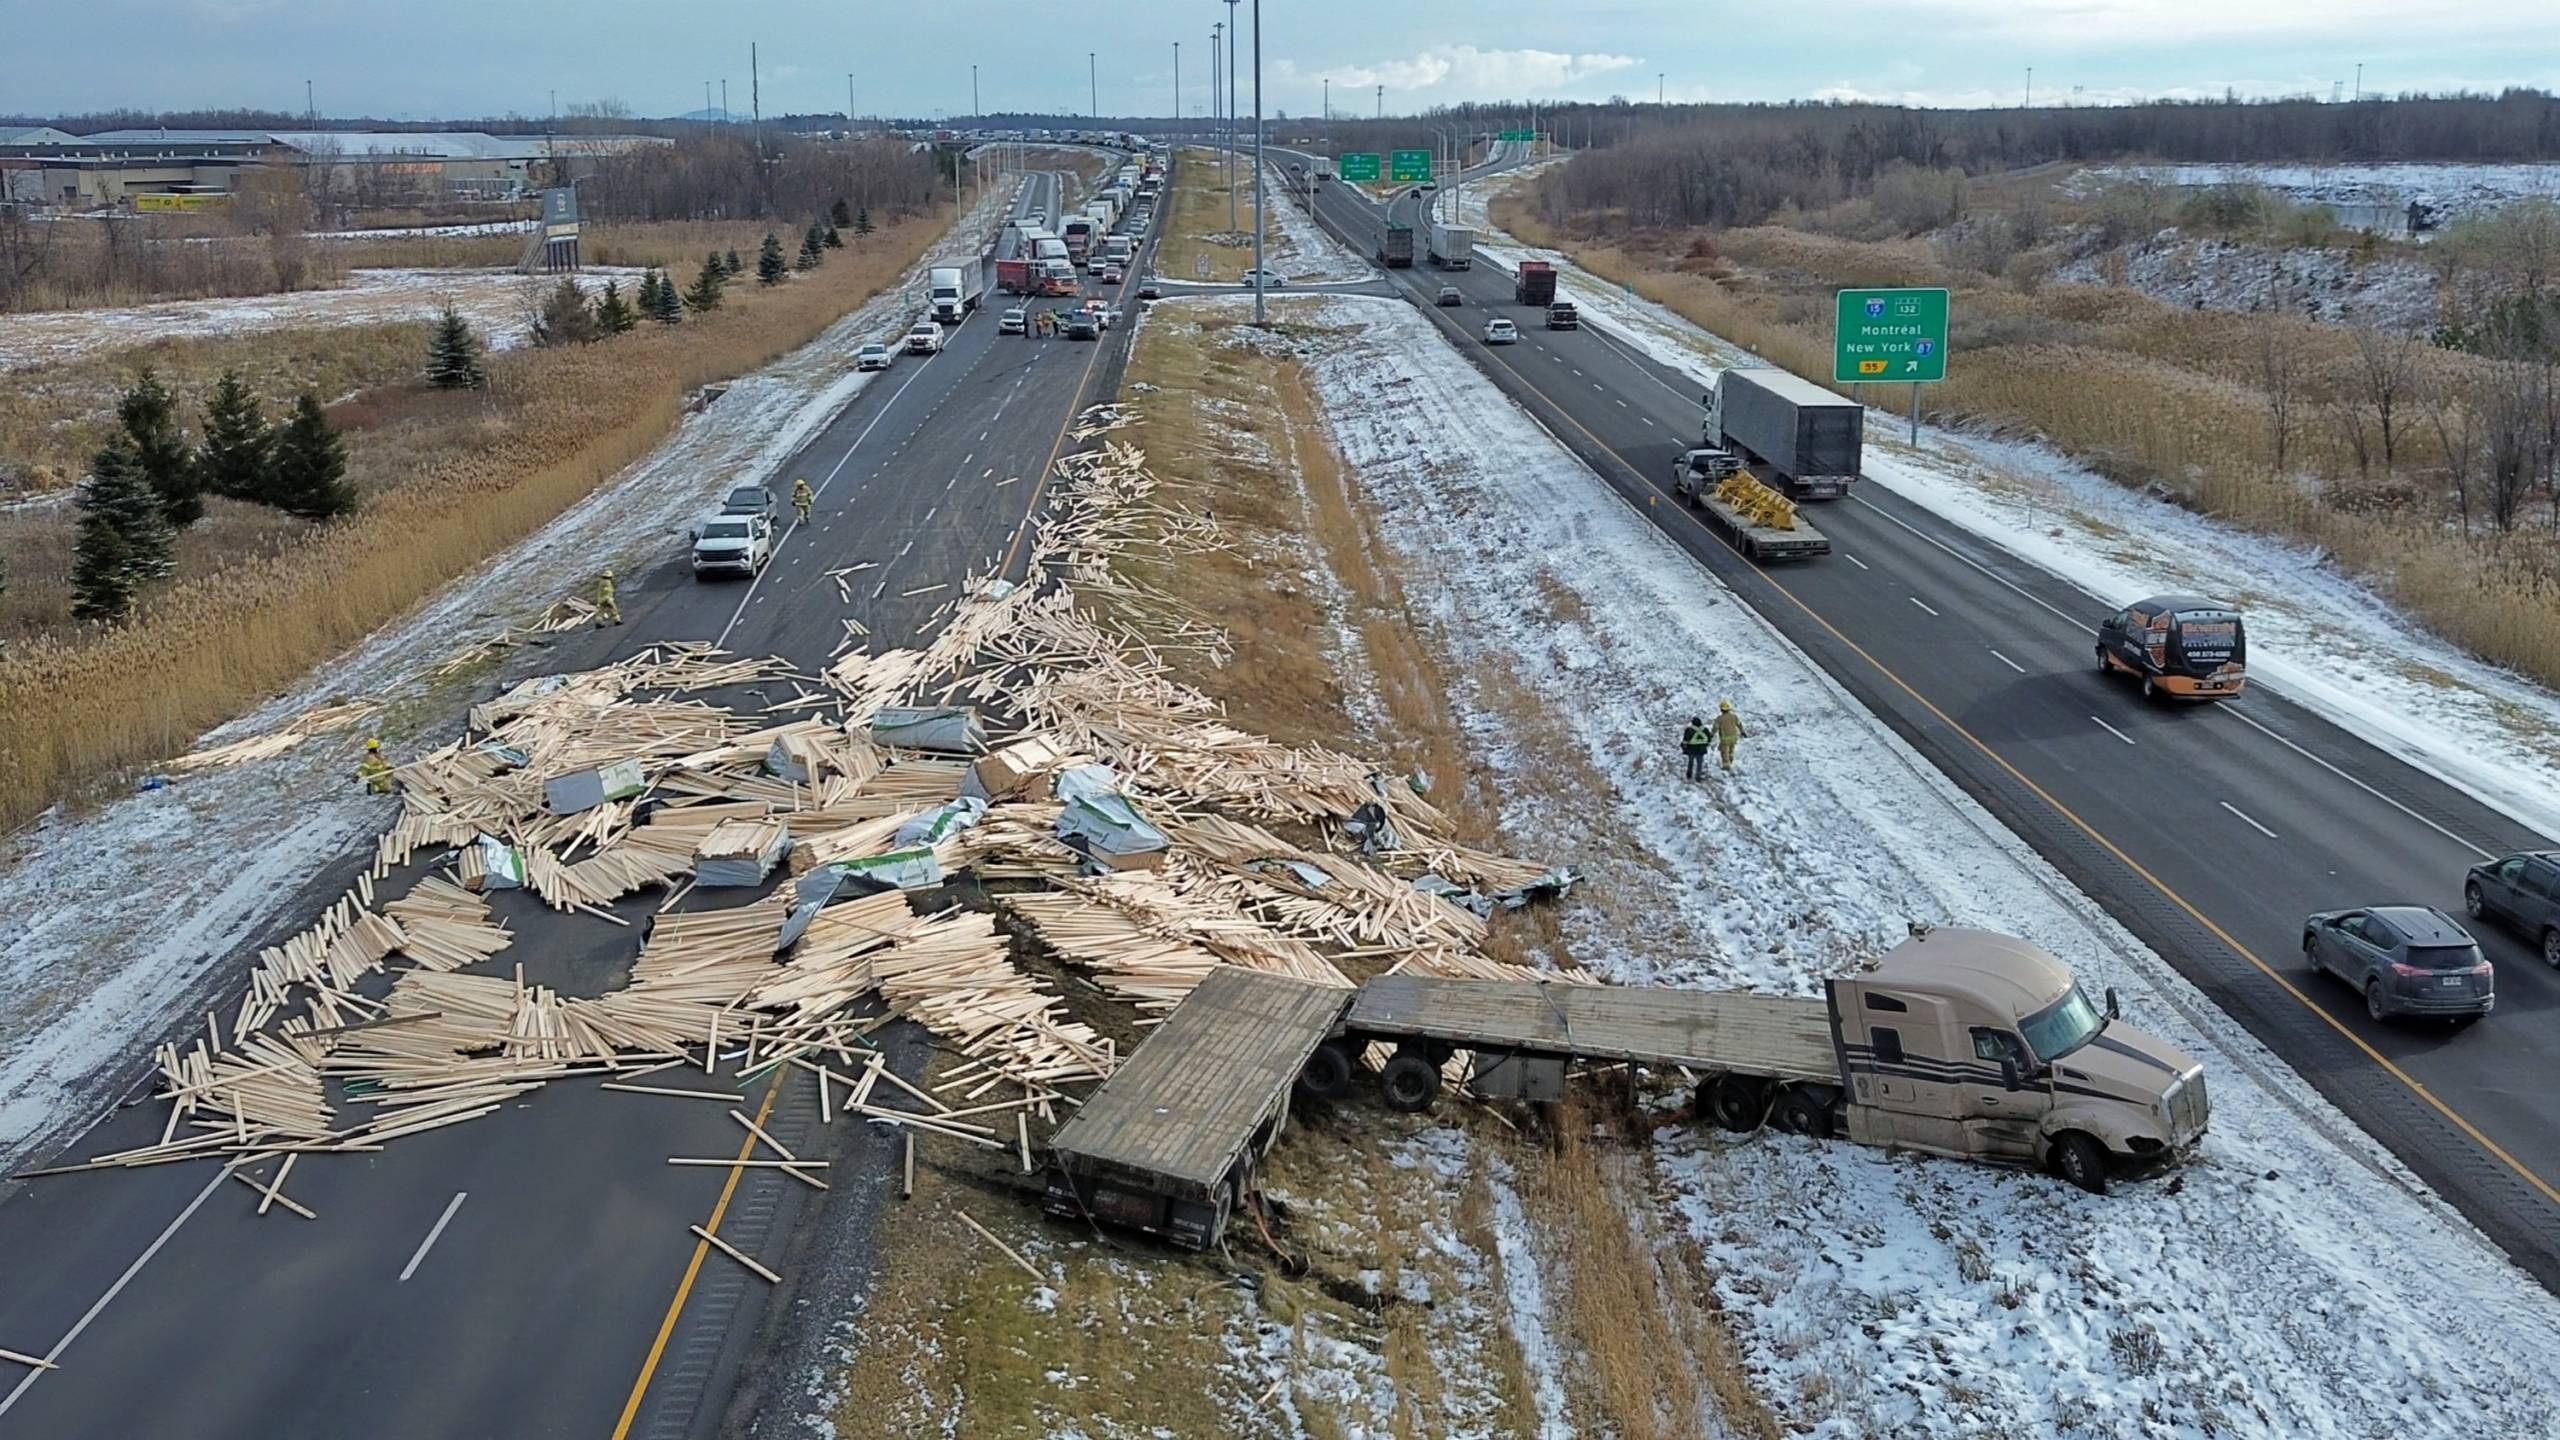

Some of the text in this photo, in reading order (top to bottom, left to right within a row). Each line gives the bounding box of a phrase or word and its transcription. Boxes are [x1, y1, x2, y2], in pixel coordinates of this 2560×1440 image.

[1870, 304, 1916, 313] 15 132
[1861, 325, 1921, 335] Montréal
[1846, 341, 1932, 353] New York 87
